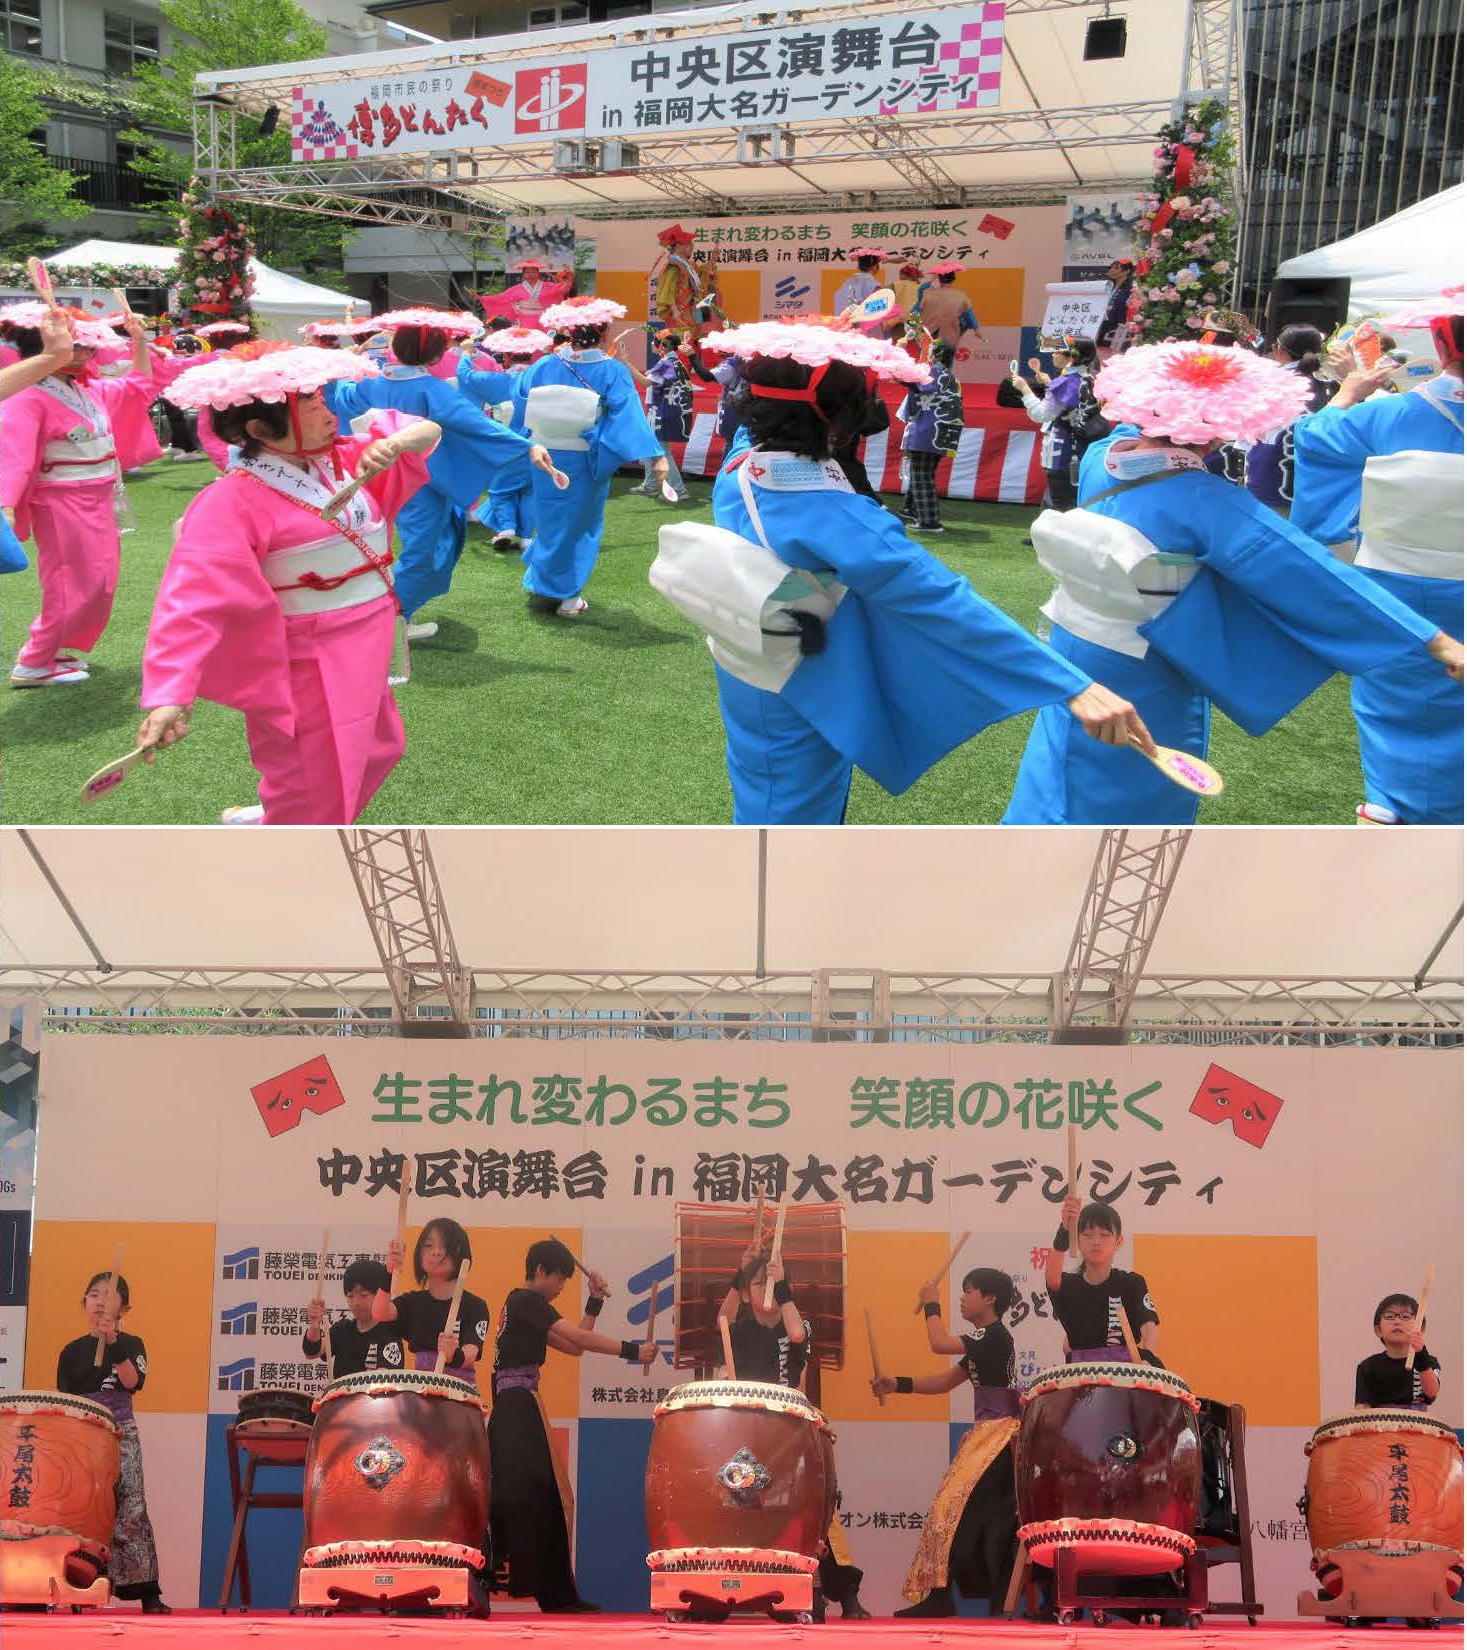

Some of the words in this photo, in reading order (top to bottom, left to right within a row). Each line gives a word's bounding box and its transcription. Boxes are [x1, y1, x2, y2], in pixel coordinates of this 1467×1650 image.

[631, 21, 942, 95] 中央区演舞台
[370, 78, 454, 100] 福岡市民の祭り
[602, 103, 622, 129] in
[633, 71, 975, 128] 福岡大名ガーデンシティ
[694, 223, 832, 244] 生まれ変わるまち
[851, 219, 969, 239] 笑顔の花咲く
[777, 249, 791, 263] in
[371, 1071, 790, 1129] 生まれ変わるまち
[849, 1076, 1164, 1132] 笑顔の花咲く
[316, 1147, 609, 1200] 中央区演舞台
[633, 1154, 674, 1197] in
[264, 1270, 305, 1281] TOUEI
[262, 1326, 303, 1336] TOUEI
[8, 1423, 38, 1509] 平尾太鼓
[1388, 1443, 1412, 1526] 平尾太鼓
[840, 1512, 929, 1530] オン株式会
[1250, 1520, 1309, 1541] 八幡宮
